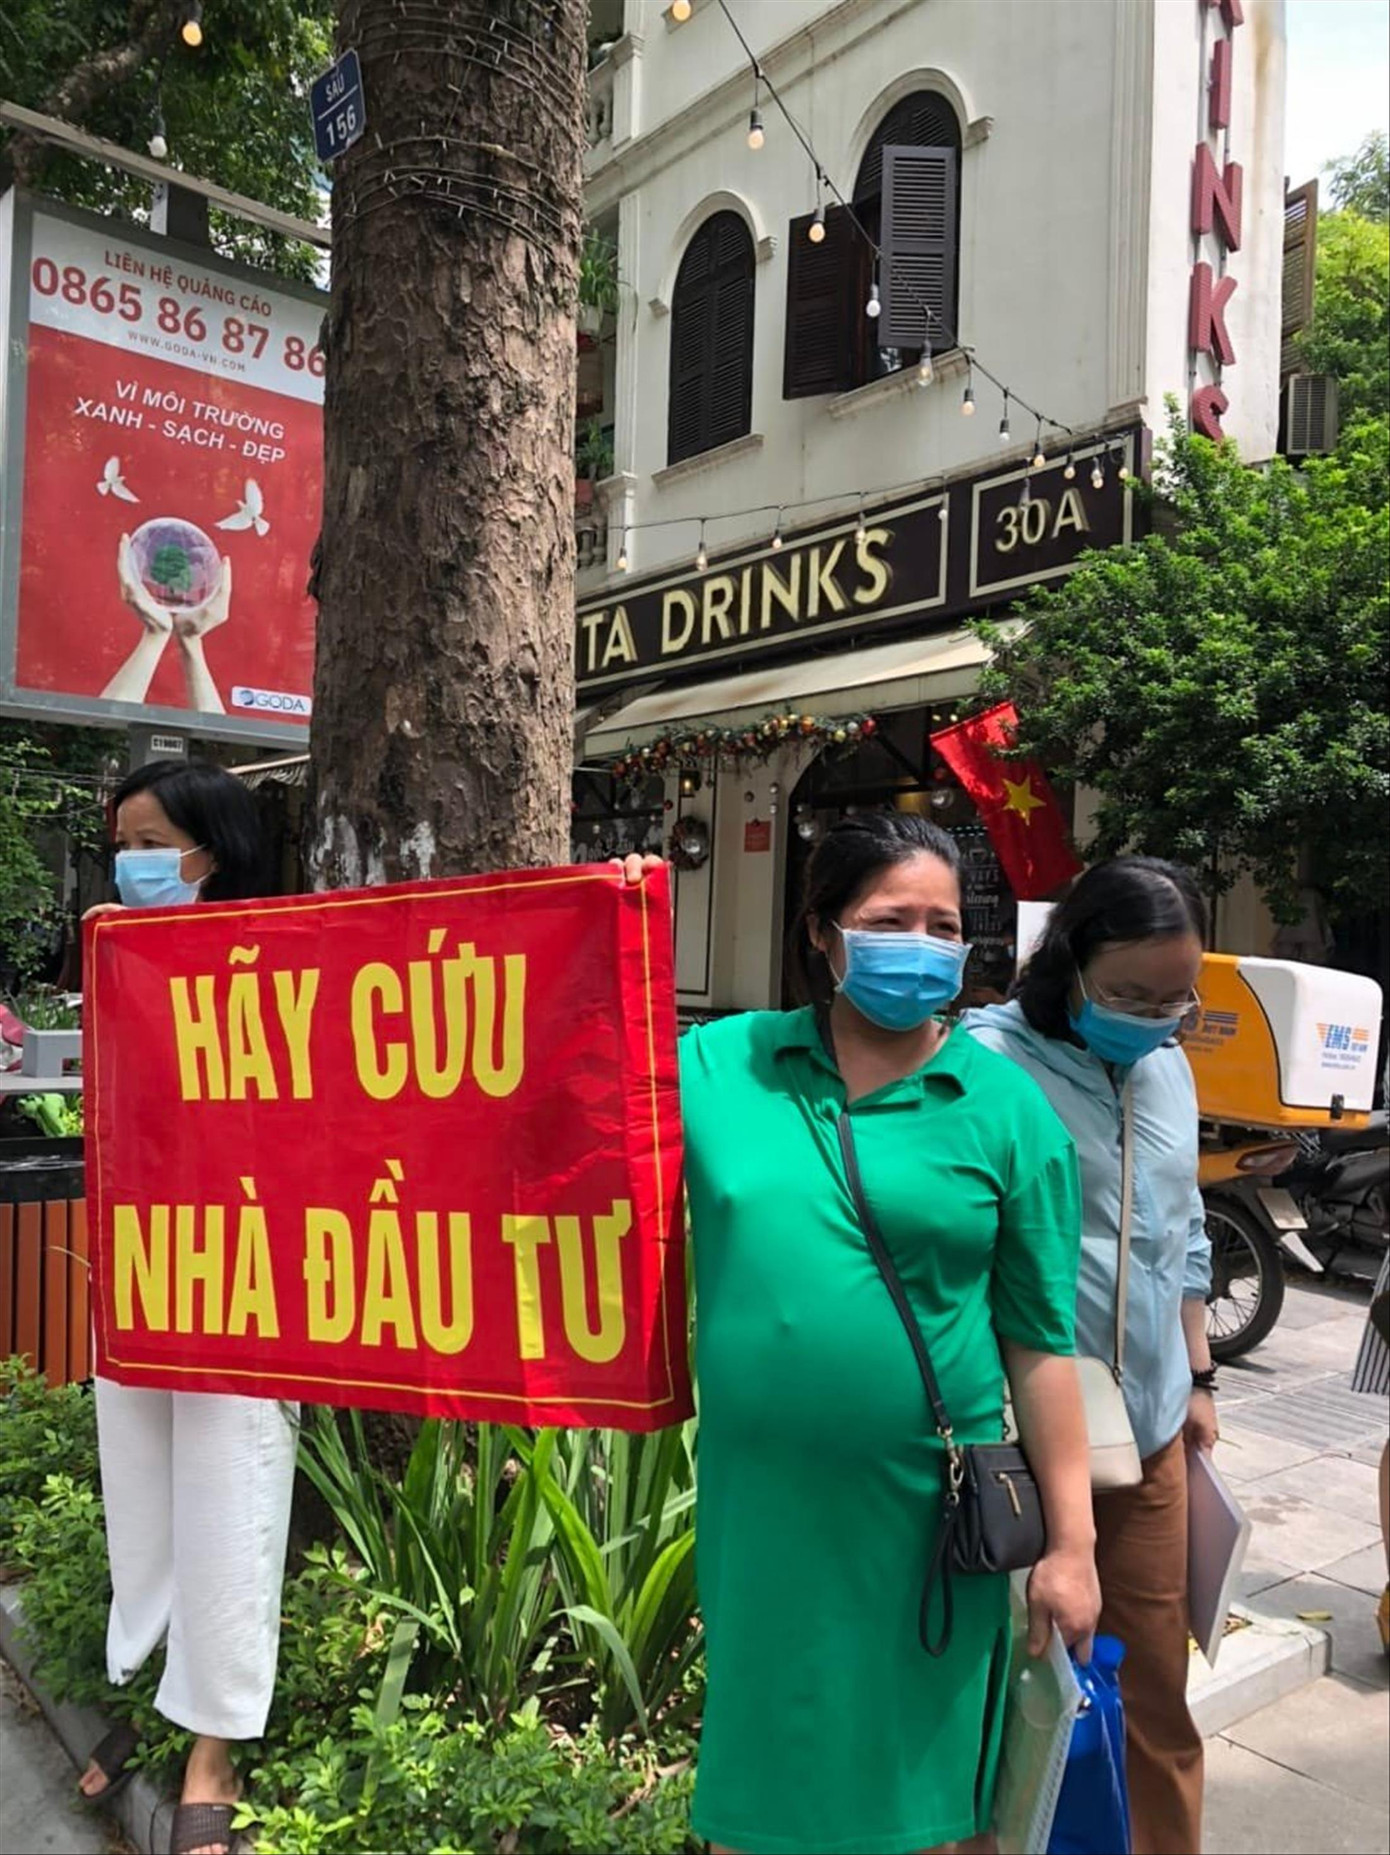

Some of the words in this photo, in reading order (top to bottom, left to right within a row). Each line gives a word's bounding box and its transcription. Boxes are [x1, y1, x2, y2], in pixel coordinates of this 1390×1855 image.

[326, 104, 356, 146] 156
[32, 257, 143, 322] 0865
[157, 297, 207, 342] 86
[222, 317, 270, 359] 87
[284, 336, 326, 377] 86
[104, 250, 145, 278] LIÊN
[150, 265, 173, 286] HỆ
[177, 274, 235, 306] QUẢNG
[240, 293, 272, 317] CÁO
[75, 397, 143, 428] XANH
[162, 420, 224, 449] SẠCH
[242, 441, 286, 464] ĐẸP
[116, 380, 138, 401] VÌ
[143, 388, 185, 414] MÔI
[192, 401, 285, 439] TRƯỜNG
[996, 487, 1090, 552] 30A
[660, 528, 895, 654] DRINKS
[256, 694, 305, 712] GODA
[169, 943, 320, 1101] HÃY
[351, 928, 526, 1100] CỨU
[113, 1176, 281, 1339] NHÀ
[303, 1159, 474, 1355] ĐẦU
[501, 1199, 632, 1363] TƯ
